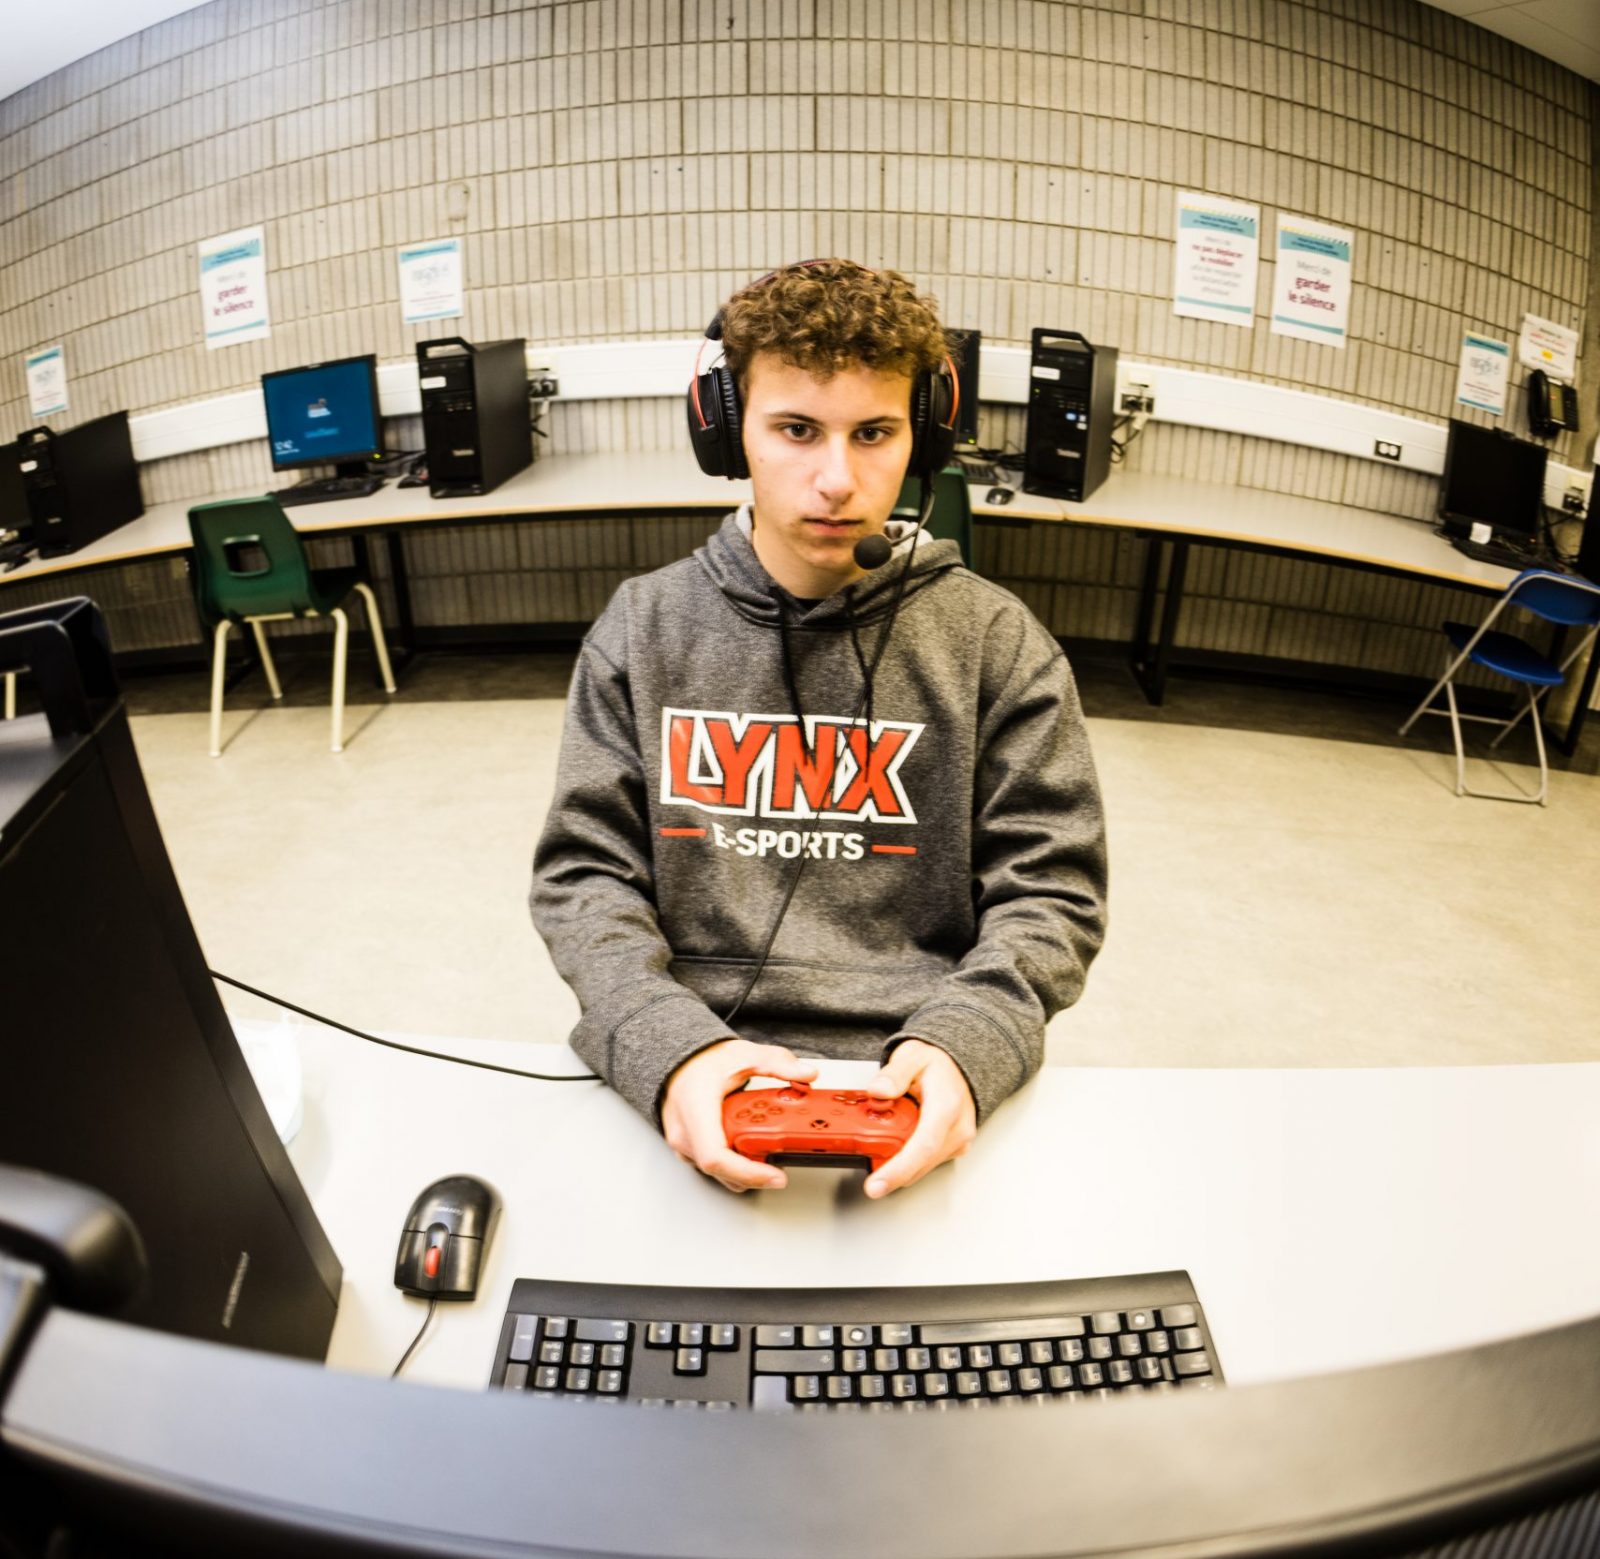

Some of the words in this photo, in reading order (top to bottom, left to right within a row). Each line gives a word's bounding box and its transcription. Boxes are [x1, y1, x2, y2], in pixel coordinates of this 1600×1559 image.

[218, 285, 248, 303] garder
[1295, 276, 1331, 293] garder
[223, 299, 254, 314] silence
[1288, 289, 1298, 303] le
[1300, 291, 1336, 312] silence
[660, 706, 925, 824] LYNX
[711, 822, 865, 860] E-SPORTS
